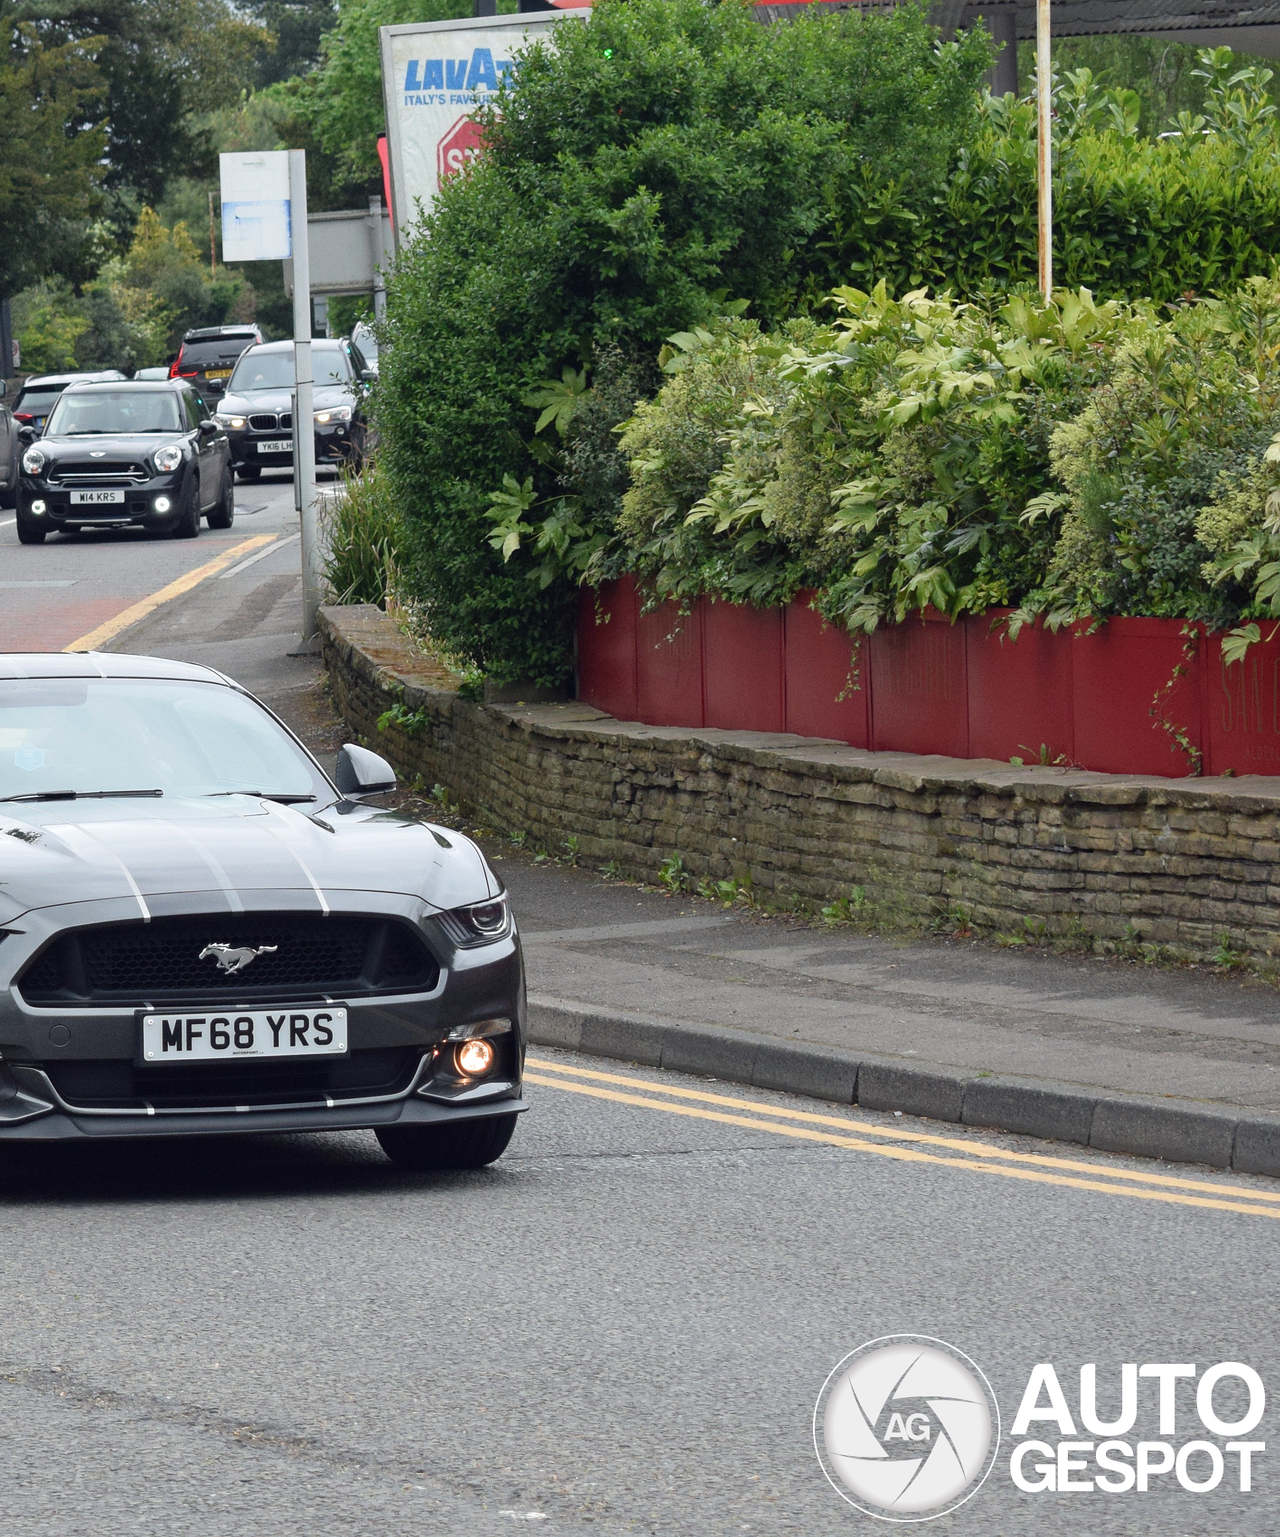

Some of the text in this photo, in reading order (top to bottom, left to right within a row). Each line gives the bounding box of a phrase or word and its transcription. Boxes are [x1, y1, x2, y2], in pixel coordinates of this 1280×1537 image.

[404, 48, 523, 91] LAVAZ
[404, 94, 446, 106] ITALY'S
[262, 441, 293, 451] YK16 LH
[79, 492, 116, 501] W14 KRS
[162, 1013, 334, 1052] MF68 YRS
